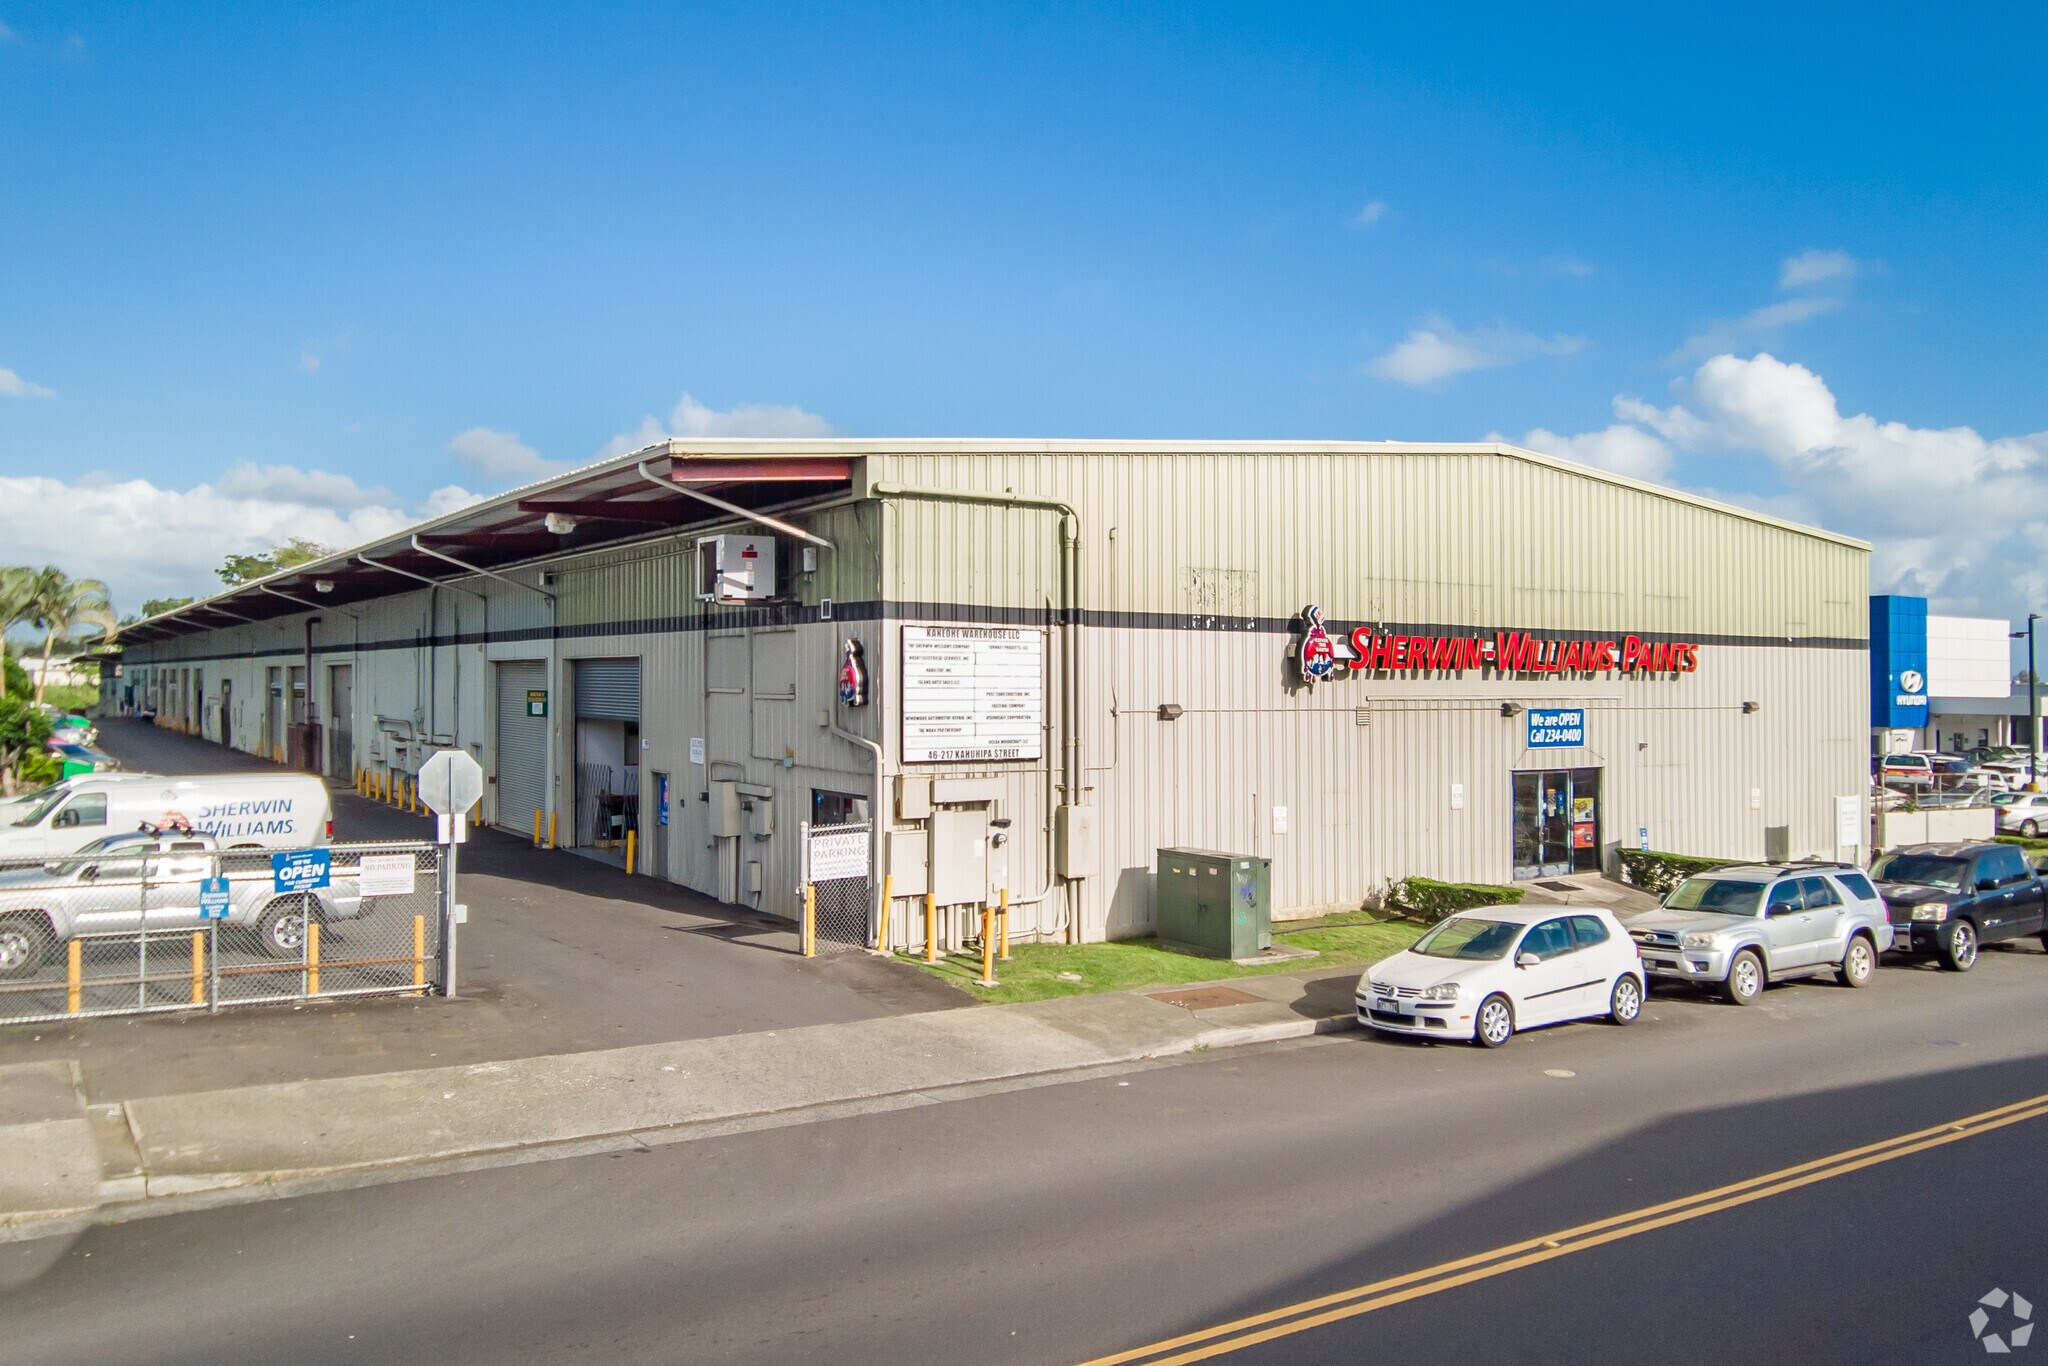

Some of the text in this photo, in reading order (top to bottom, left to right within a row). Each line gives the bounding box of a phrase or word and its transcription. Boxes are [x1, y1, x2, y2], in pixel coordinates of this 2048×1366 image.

[926, 629, 1020, 640] KANEOHE WAREHOUSE LLC
[1622, 635, 1699, 673] PAINTS
[1896, 695, 1927, 705] HYUNDAI
[1531, 713, 1581, 727] We are OPEN
[1531, 729, 1582, 743] Call 234-0400
[927, 749, 1020, 760] 46-217 KAHUHIPA STREET
[199, 799, 293, 818] SHERWIN
[198, 819, 294, 839] WILLIAMS
[814, 834, 865, 849] PRIVATE
[814, 845, 866, 860] PARKING
[279, 863, 325, 880] OPEN
